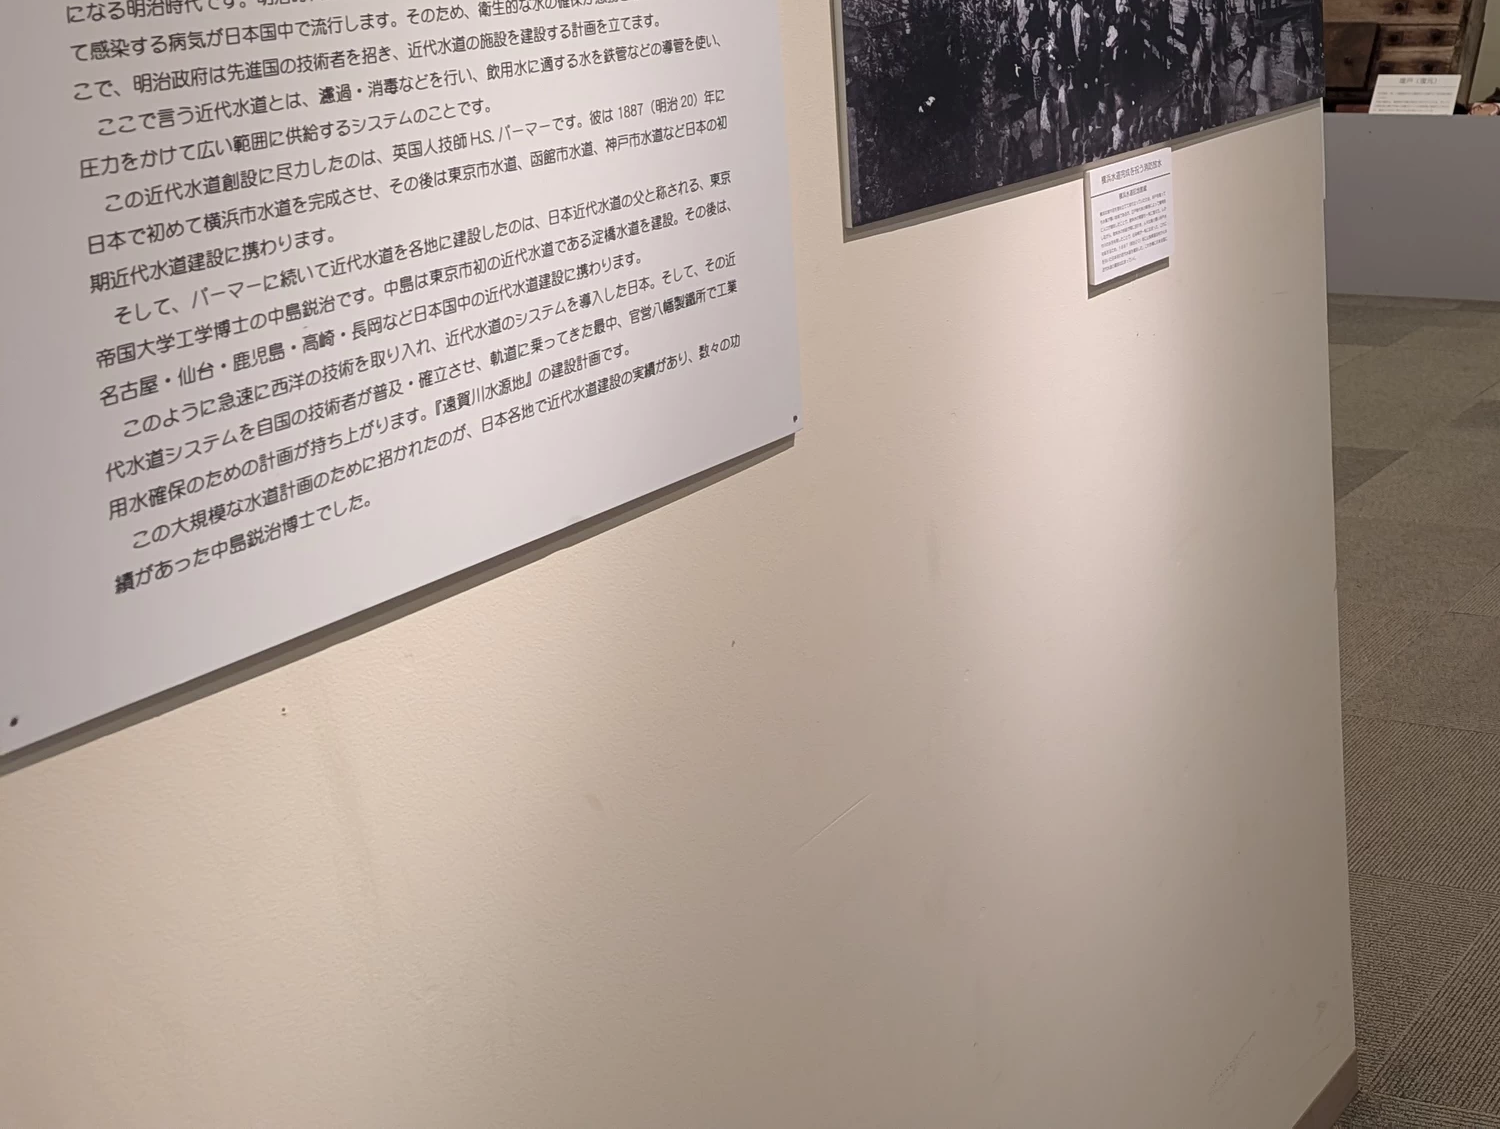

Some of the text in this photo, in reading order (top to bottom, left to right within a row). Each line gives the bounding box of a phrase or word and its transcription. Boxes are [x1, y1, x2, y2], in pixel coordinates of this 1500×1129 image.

[74, 13, 659, 100] こで、明治政府は先進国の技術者を招き、近代水道の施設を建設する計画を立てます。
[81, 98, 490, 179] 圧力をかけて広い範囲に供給するシステムのことです。
[88, 116, 727, 254] 日本で初めて横浜市水道を完成させ、その後は東京市水道、函館市水道、神戸市水道など日本の初
[90, 227, 334, 293] 期近代水道建設に携わります。
[100, 251, 641, 406] 名古屋・仙台・鹿児島・高崎・長岡など日本国中の近代水道建設に携わります。
[124, 251, 736, 437] このように急速に西洋の技術を取り入れ、近代水道のシステムを導入した日本。そして、その近
[115, 495, 370, 594] 績があった中島鋭治博士でした。
